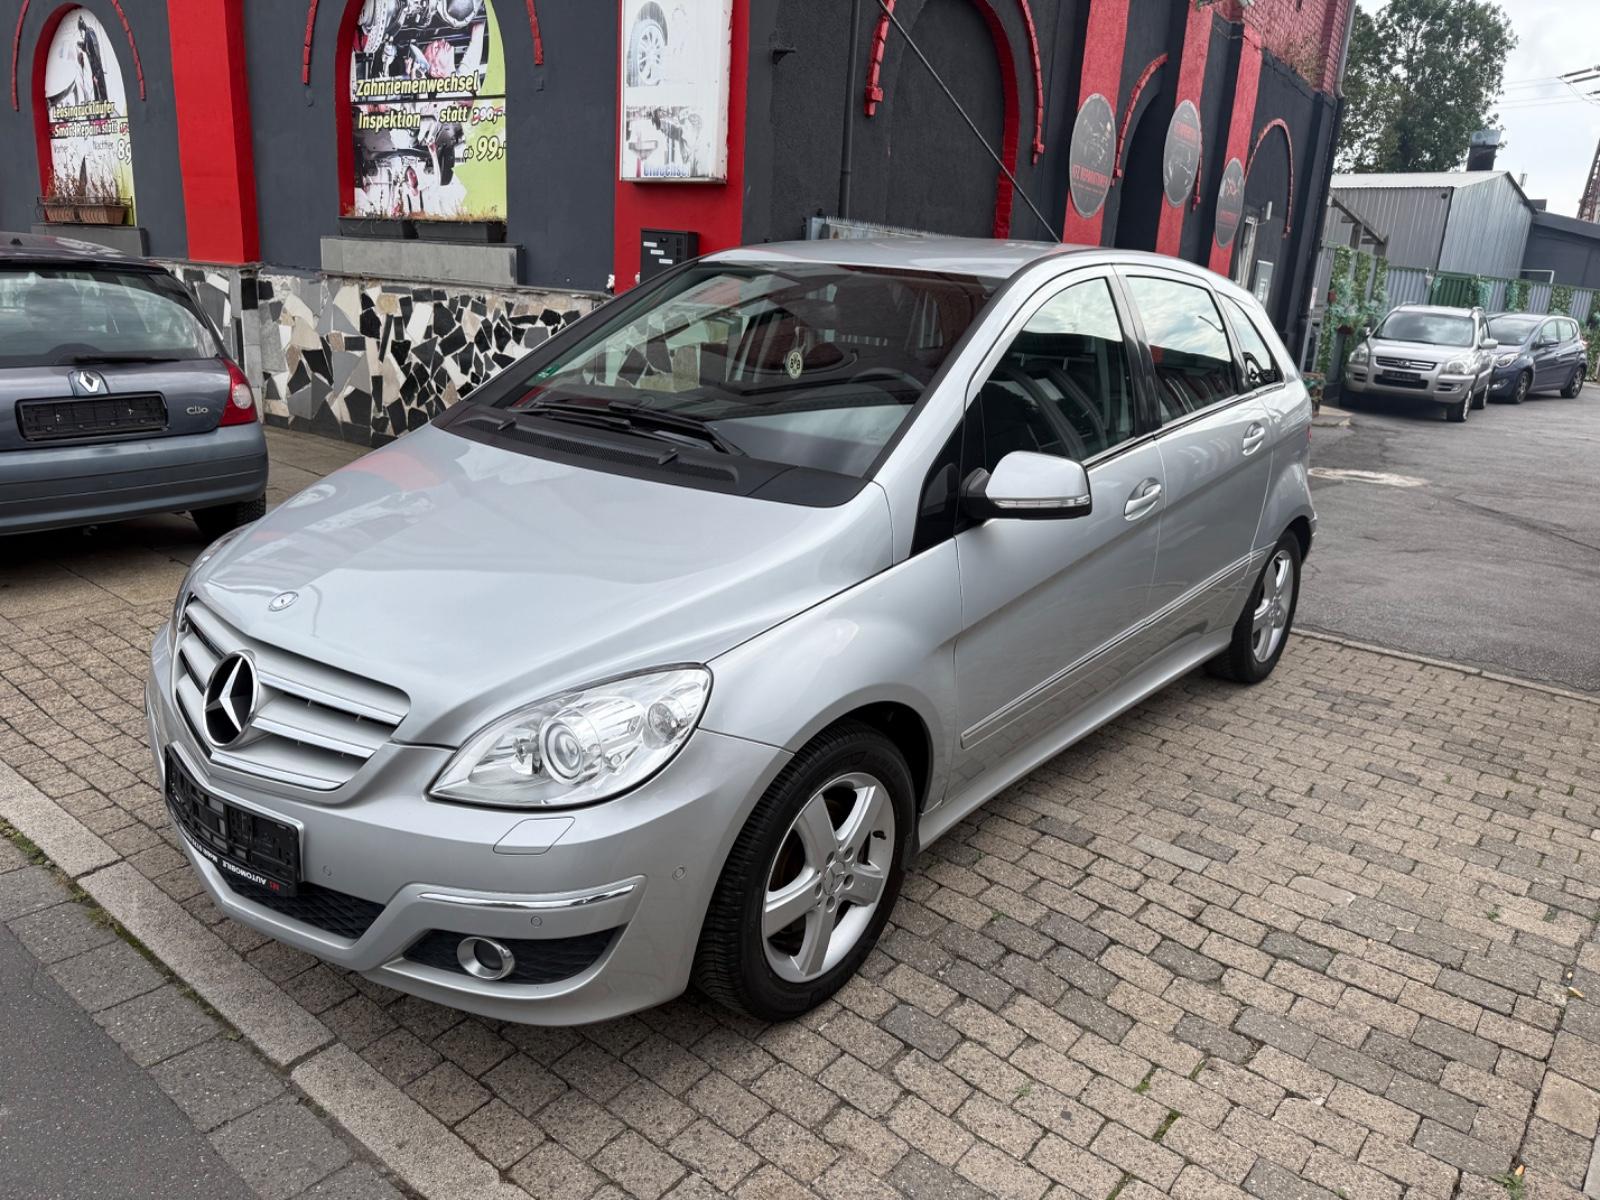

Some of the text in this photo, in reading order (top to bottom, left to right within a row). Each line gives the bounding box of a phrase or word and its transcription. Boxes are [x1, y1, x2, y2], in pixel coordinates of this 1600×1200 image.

[356, 69, 479, 97] Zahnriemenwechsel
[358, 110, 421, 133] Inspektion
[439, 105, 468, 123] statt
[186, 404, 209, 415] Clio
[222, 860, 267, 885] AUTOMOBILE
